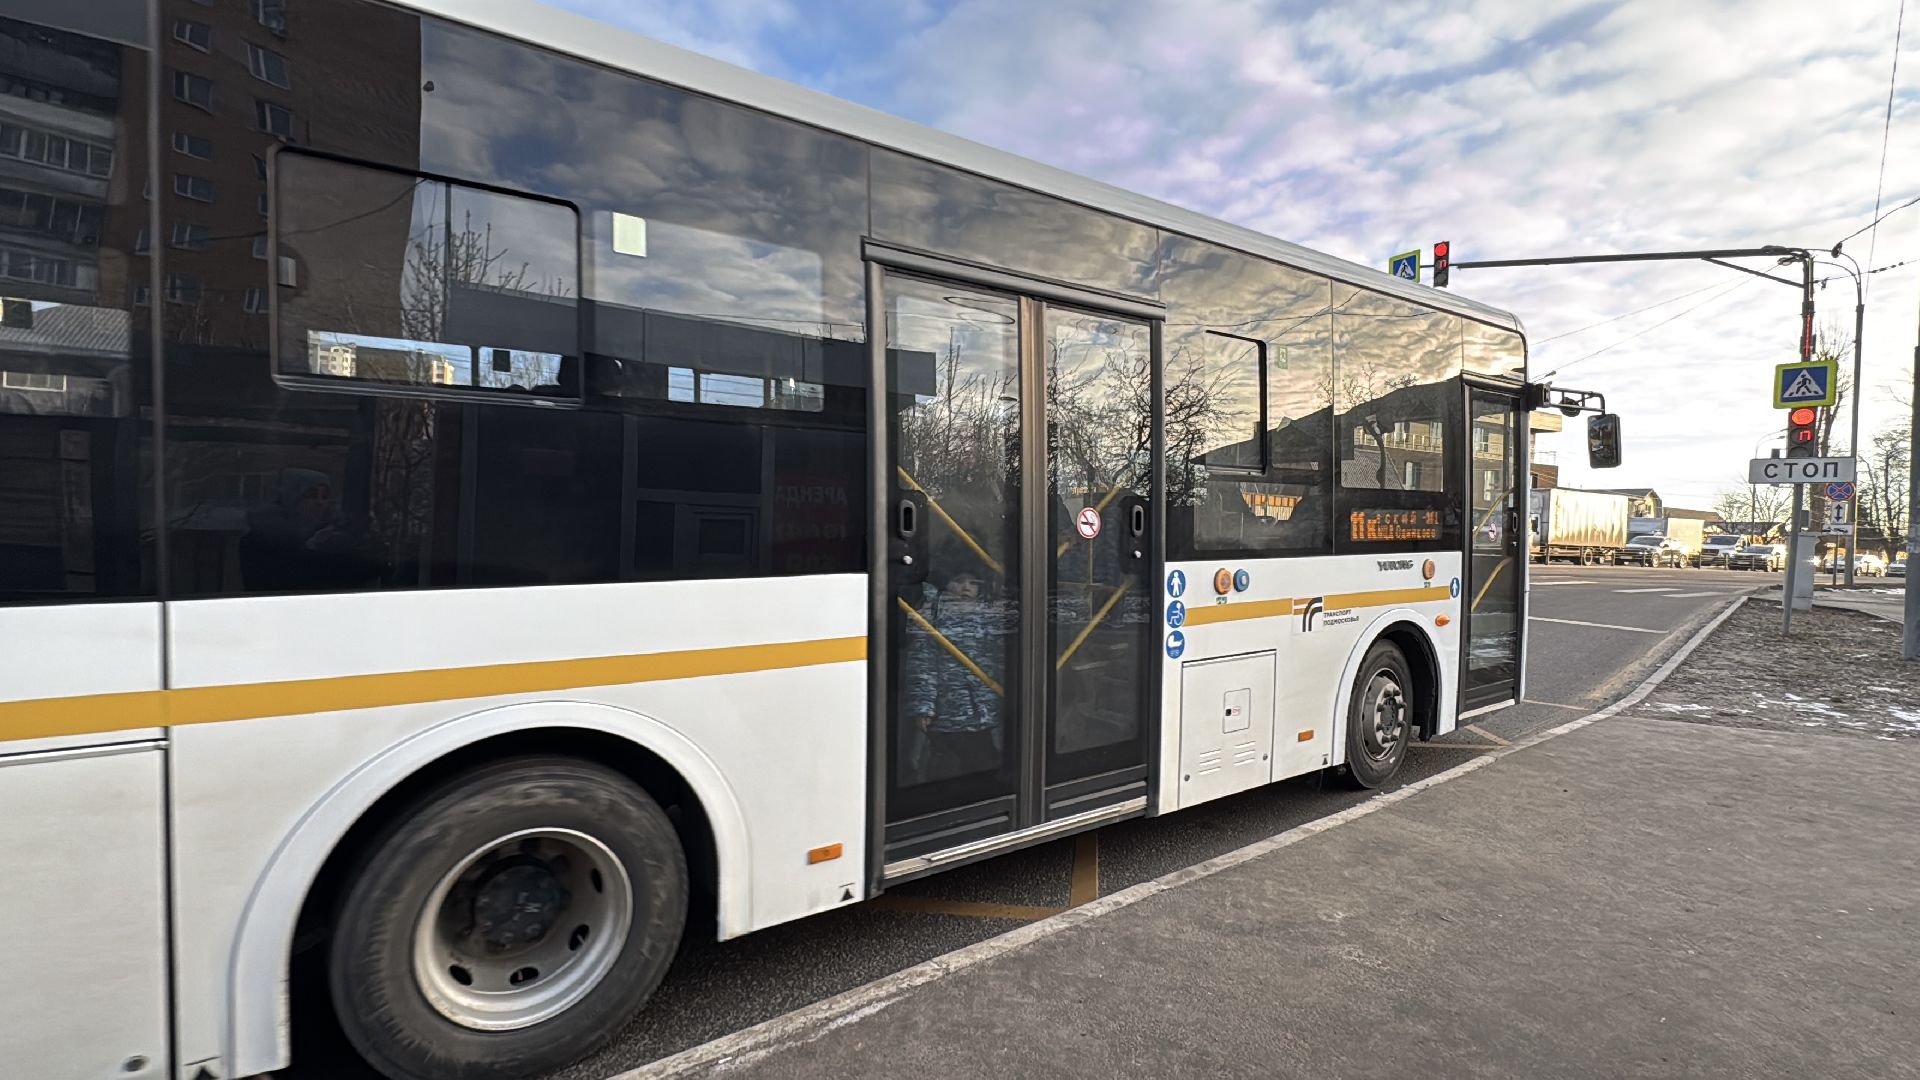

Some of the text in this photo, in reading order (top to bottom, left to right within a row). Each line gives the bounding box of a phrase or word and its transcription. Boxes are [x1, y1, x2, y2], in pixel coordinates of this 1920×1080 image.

[1764, 462, 1838, 478] СТОП
[1323, 609, 1351, 618] ТРАНСПОРТ
[1323, 616, 1359, 625] ПОДМОСКОВЬЯ
